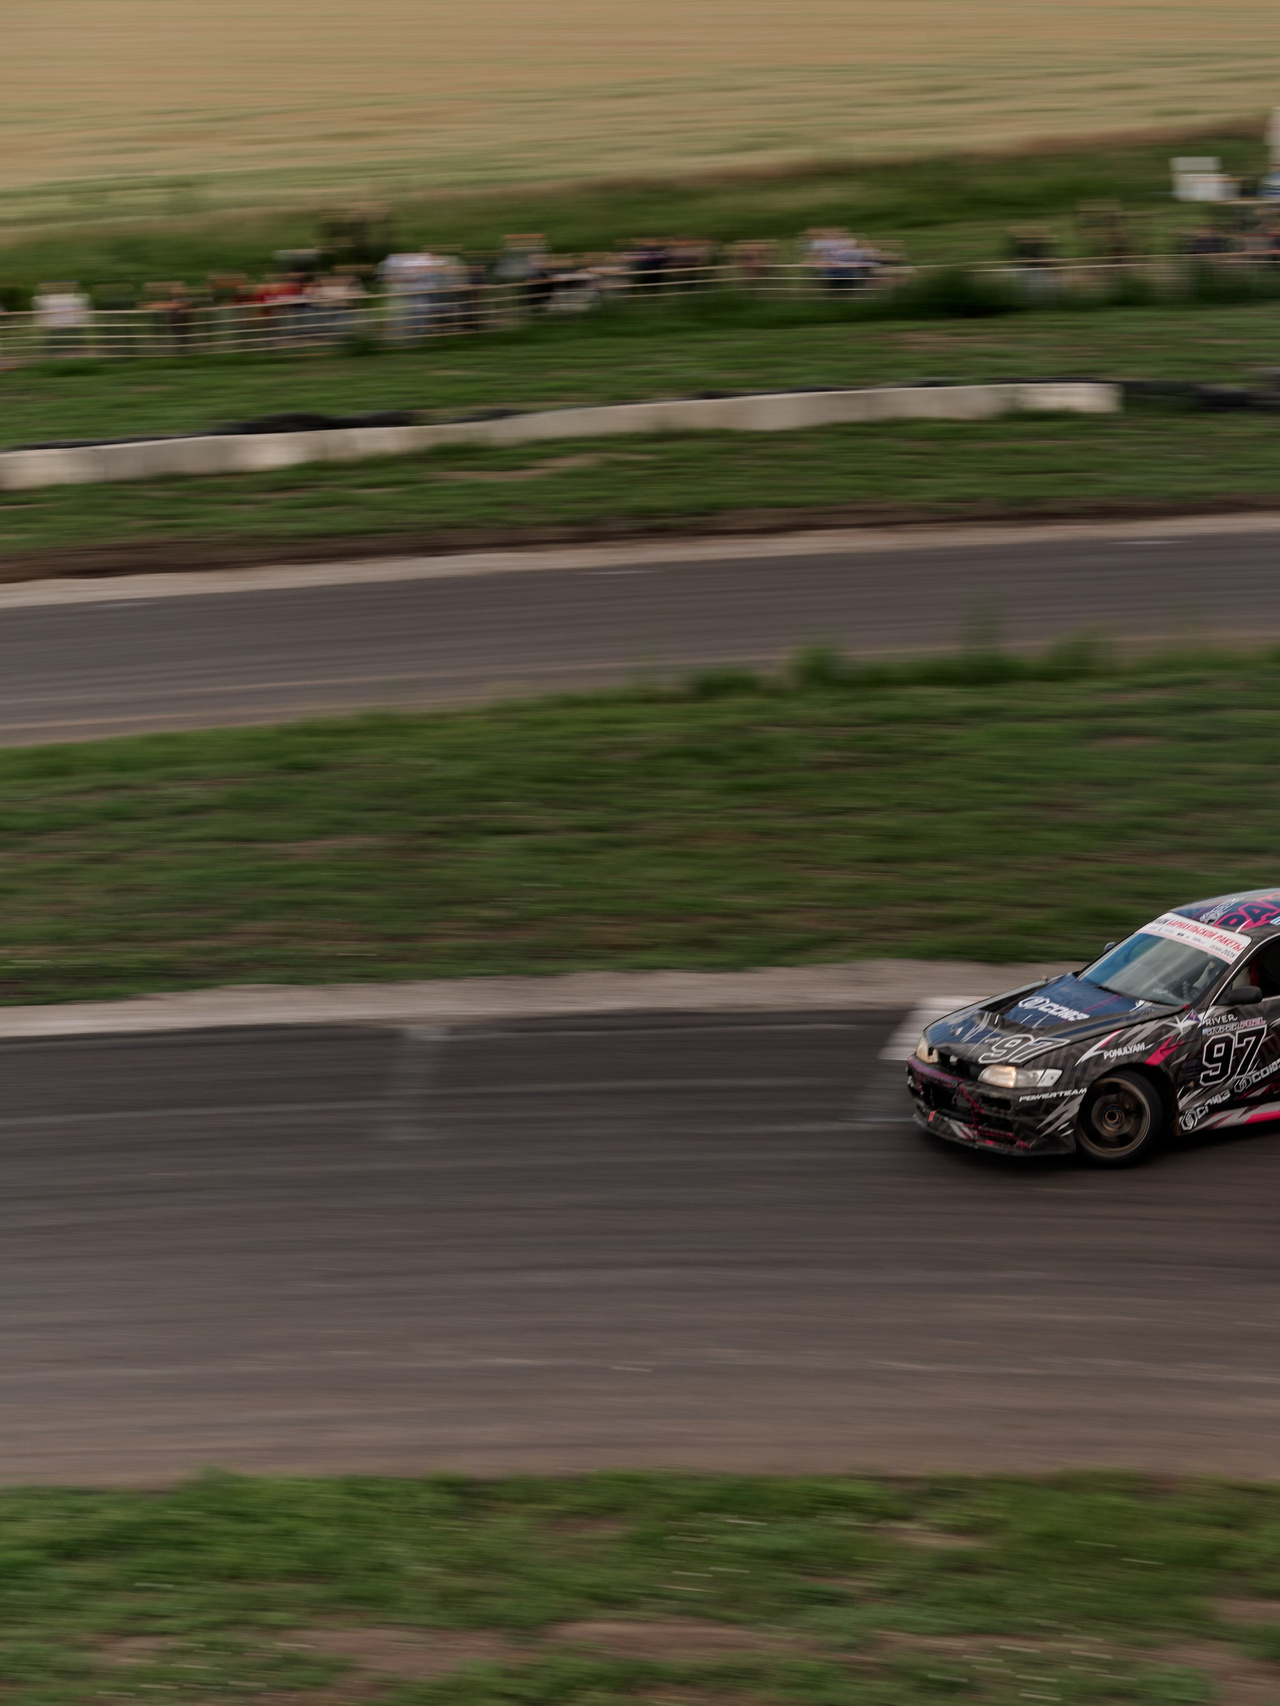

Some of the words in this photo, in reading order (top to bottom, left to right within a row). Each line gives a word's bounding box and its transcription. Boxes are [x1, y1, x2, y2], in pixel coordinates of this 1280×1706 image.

[1213, 934, 1246, 952] РАКЕТЫ
[978, 1033, 1071, 1064] 97
[1103, 1042, 1146, 1061] PONULYAM
[1199, 1024, 1268, 1087] 97
[1019, 1087, 1088, 1102] POWERTEAM
